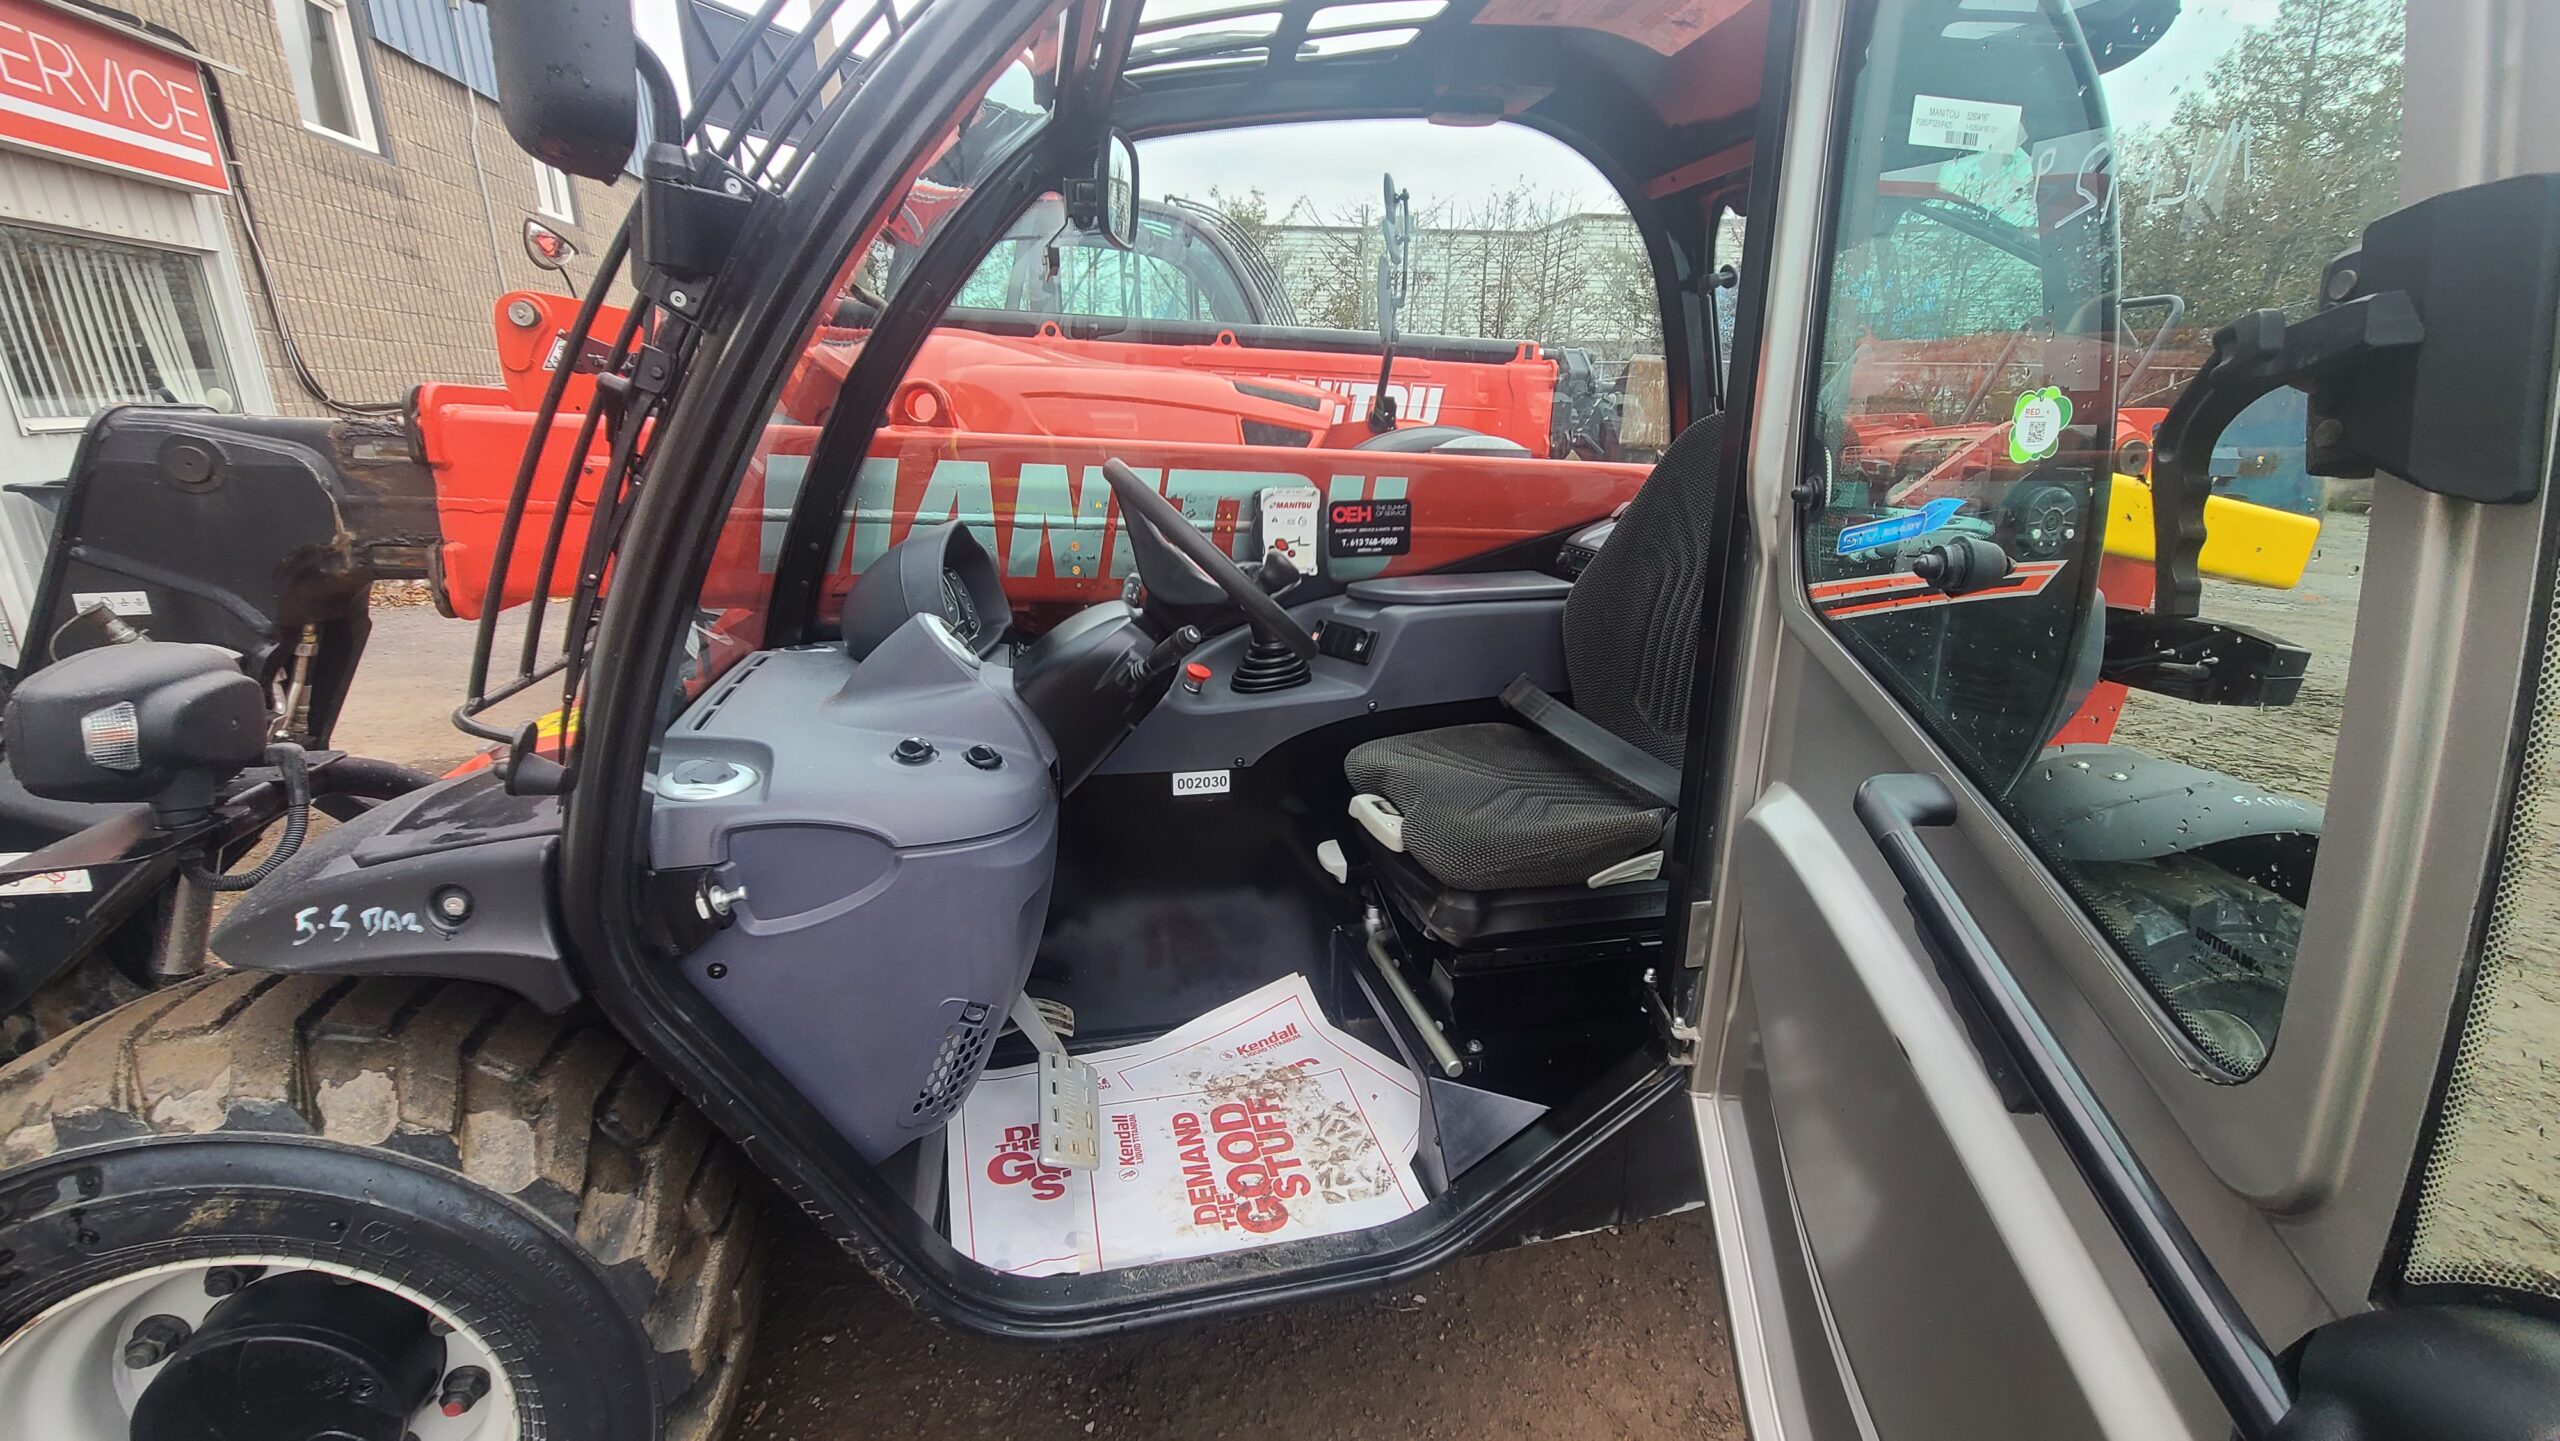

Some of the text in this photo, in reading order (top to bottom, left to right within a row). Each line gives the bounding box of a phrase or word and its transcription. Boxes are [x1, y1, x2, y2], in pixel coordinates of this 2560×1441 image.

[1928, 106, 1961, 120] MANITOU
[1275, 501, 1313, 509] MANITOU
[1332, 505, 1372, 523] OEH
[1177, 775, 1228, 790] 002030
[1236, 1022, 1299, 1055] Kendall
[1242, 1033, 1303, 1059] LIQUID TITANIUM
[994, 1138, 1040, 1153] THE
[1111, 1115, 1136, 1166] Kendall
[1128, 1113, 1145, 1165] LIQUID TITANIUM
[1171, 1112, 1221, 1226] DEMAND
[1209, 1103, 1290, 1234] GOOD
[1216, 1192, 1238, 1231] THE
